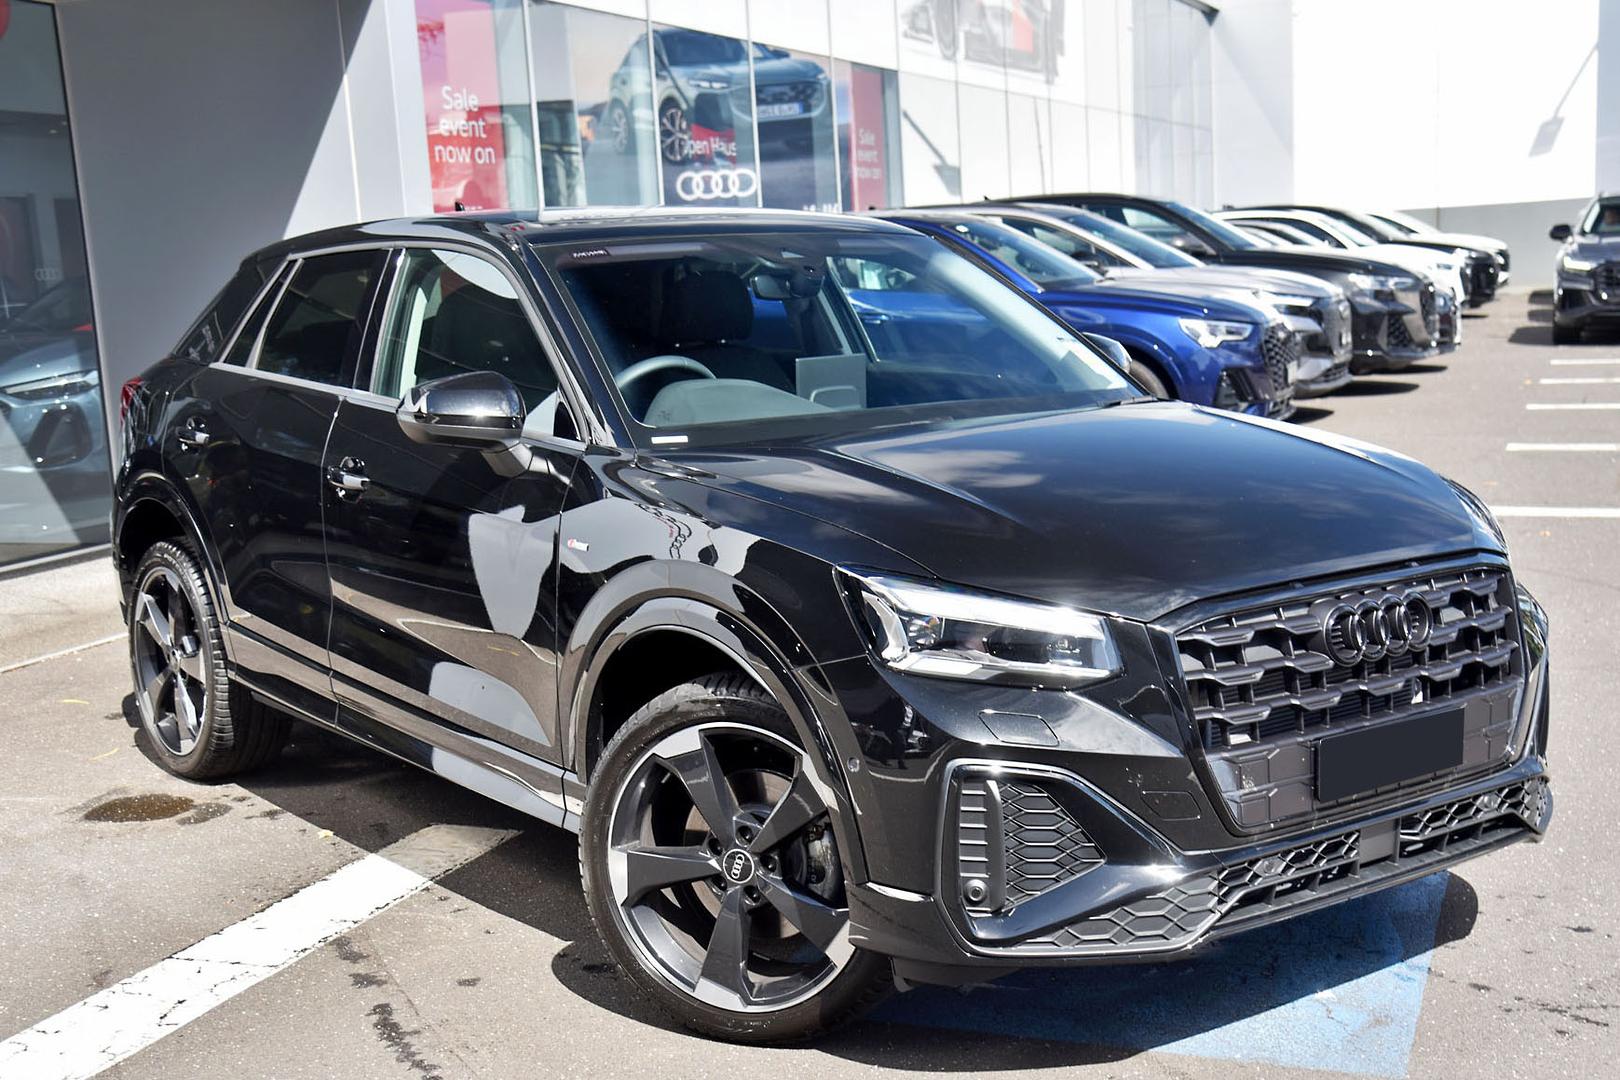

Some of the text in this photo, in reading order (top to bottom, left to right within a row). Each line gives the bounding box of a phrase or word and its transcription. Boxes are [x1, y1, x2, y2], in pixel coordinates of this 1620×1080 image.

[441, 85, 479, 112] Sale
[439, 117, 487, 138] event
[434, 144, 496, 165] now on
